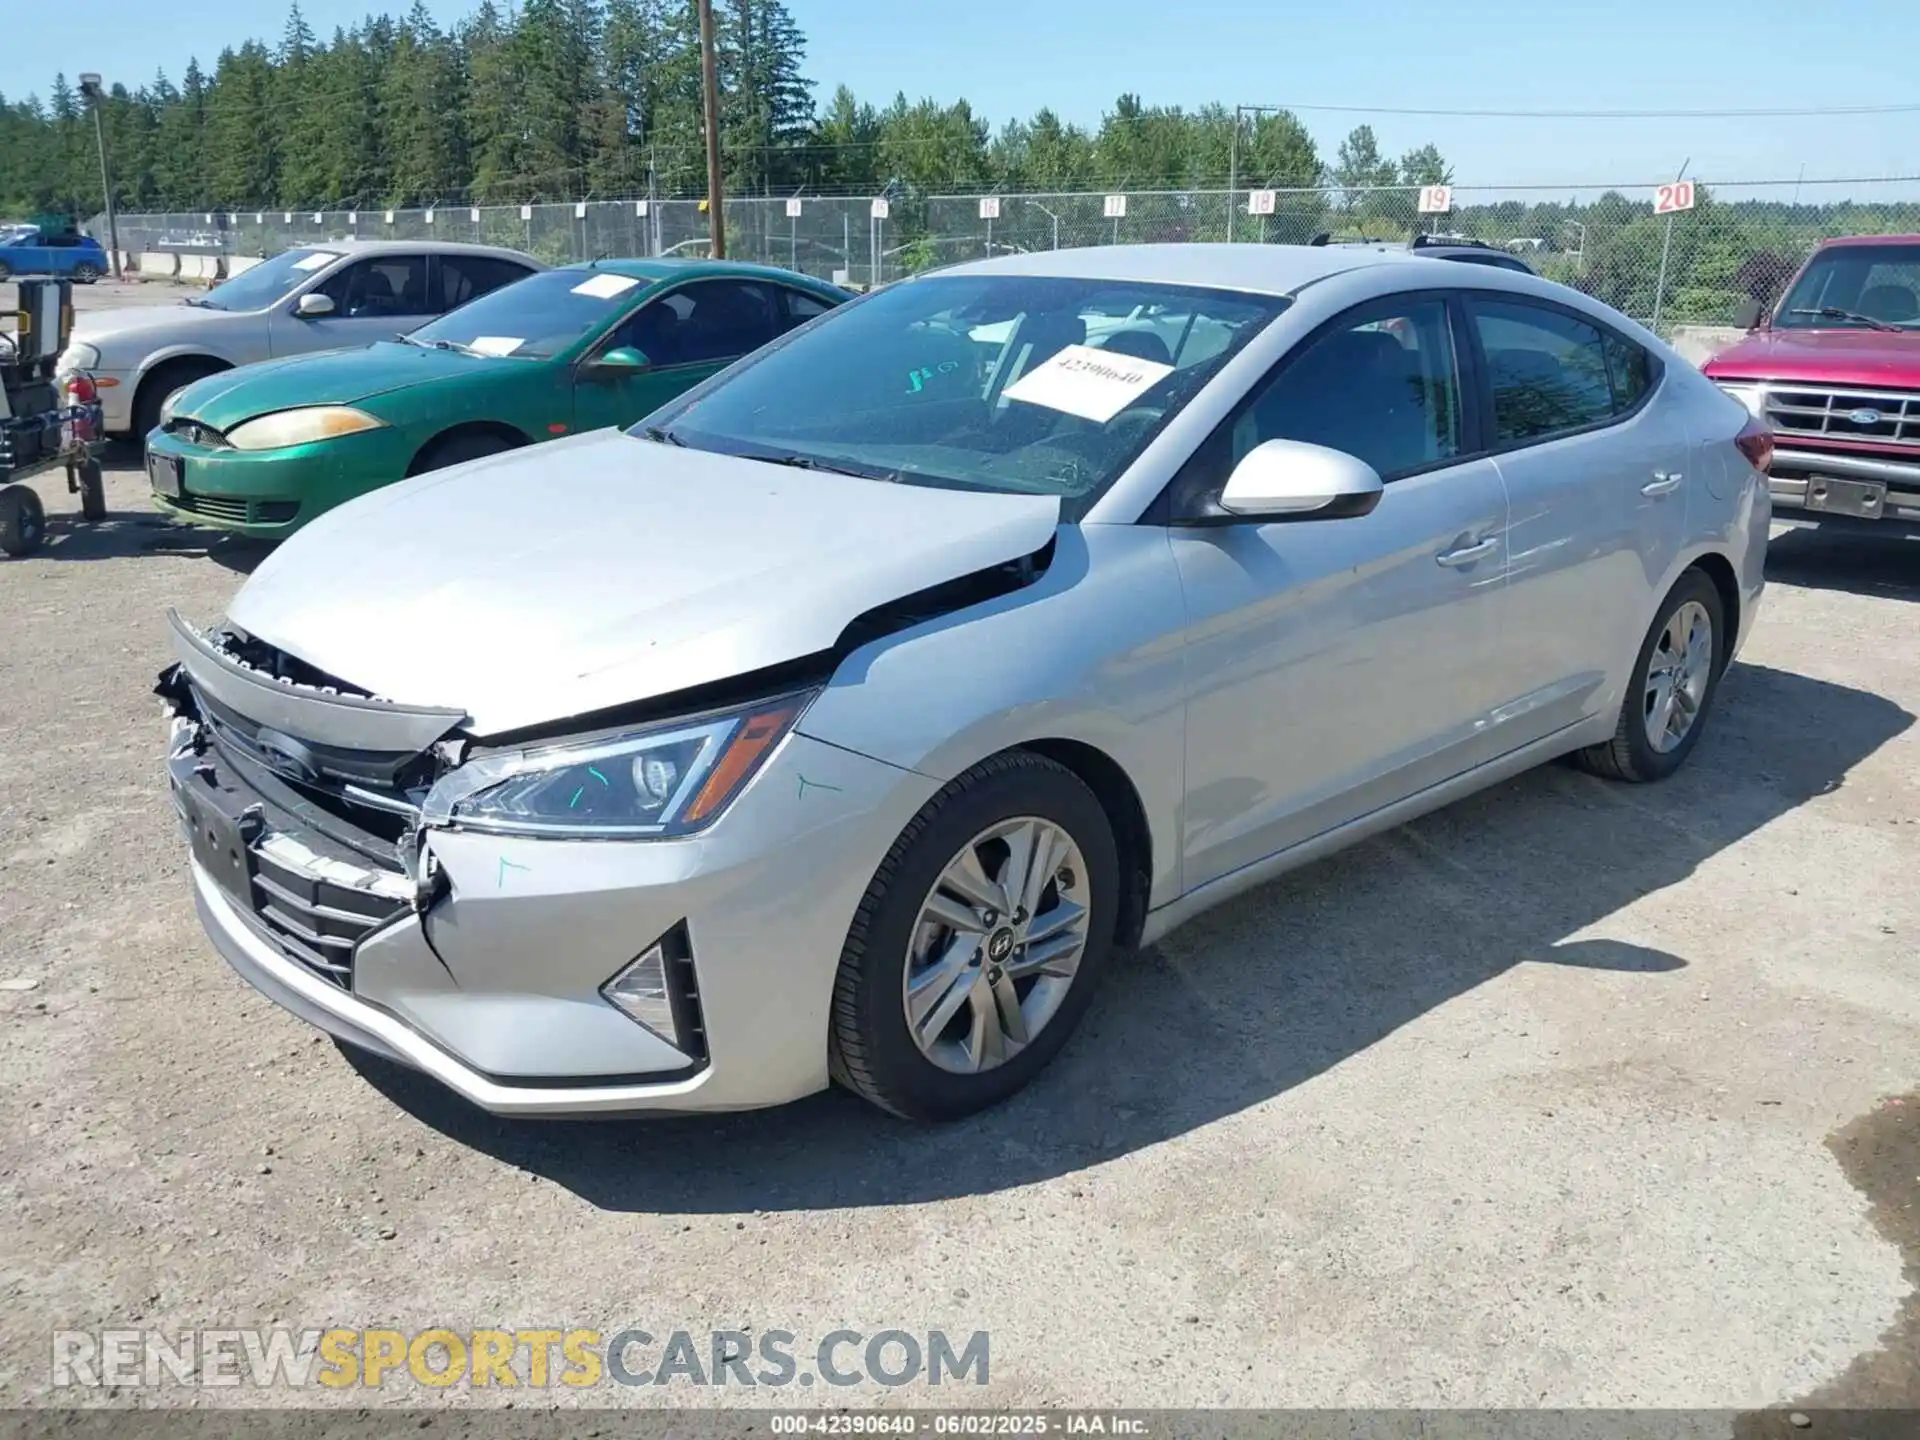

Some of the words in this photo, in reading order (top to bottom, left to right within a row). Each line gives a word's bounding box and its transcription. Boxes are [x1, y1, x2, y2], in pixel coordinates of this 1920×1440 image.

[1426, 188, 1445, 209] 19
[1658, 183, 1690, 210] 20
[984, 199, 997, 217] 16
